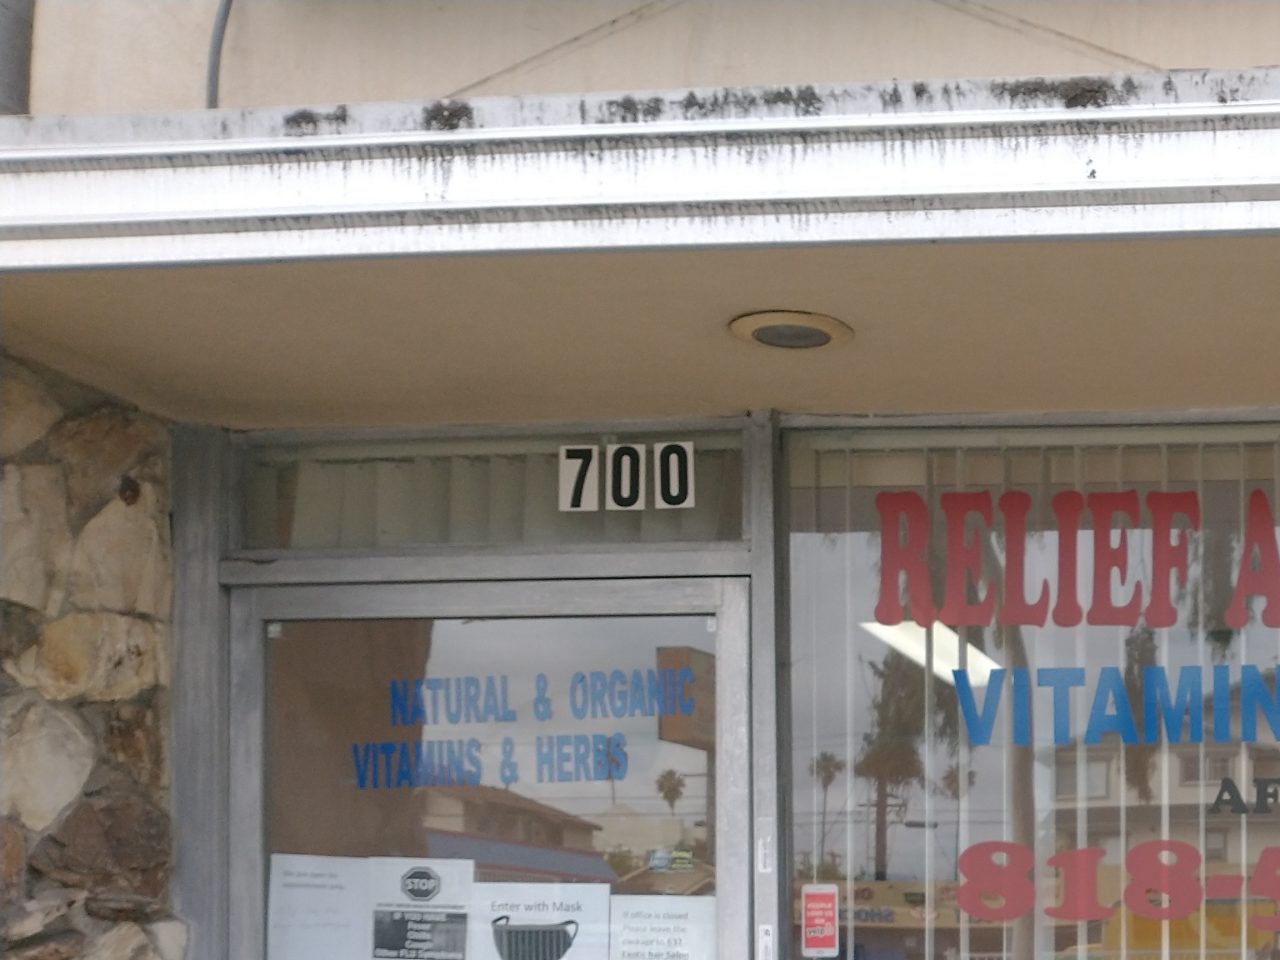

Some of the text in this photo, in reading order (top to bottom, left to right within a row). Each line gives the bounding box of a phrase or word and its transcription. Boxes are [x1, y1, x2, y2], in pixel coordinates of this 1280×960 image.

[565, 444, 689, 509] 700
[874, 489, 1200, 628] RELIEF
[389, 666, 696, 728] NATURAL & ORGANIC
[352, 732, 629, 790] VITAMINS & HERBS
[406, 877, 437, 891] STOP
[491, 901, 583, 913] Enter with Mask
